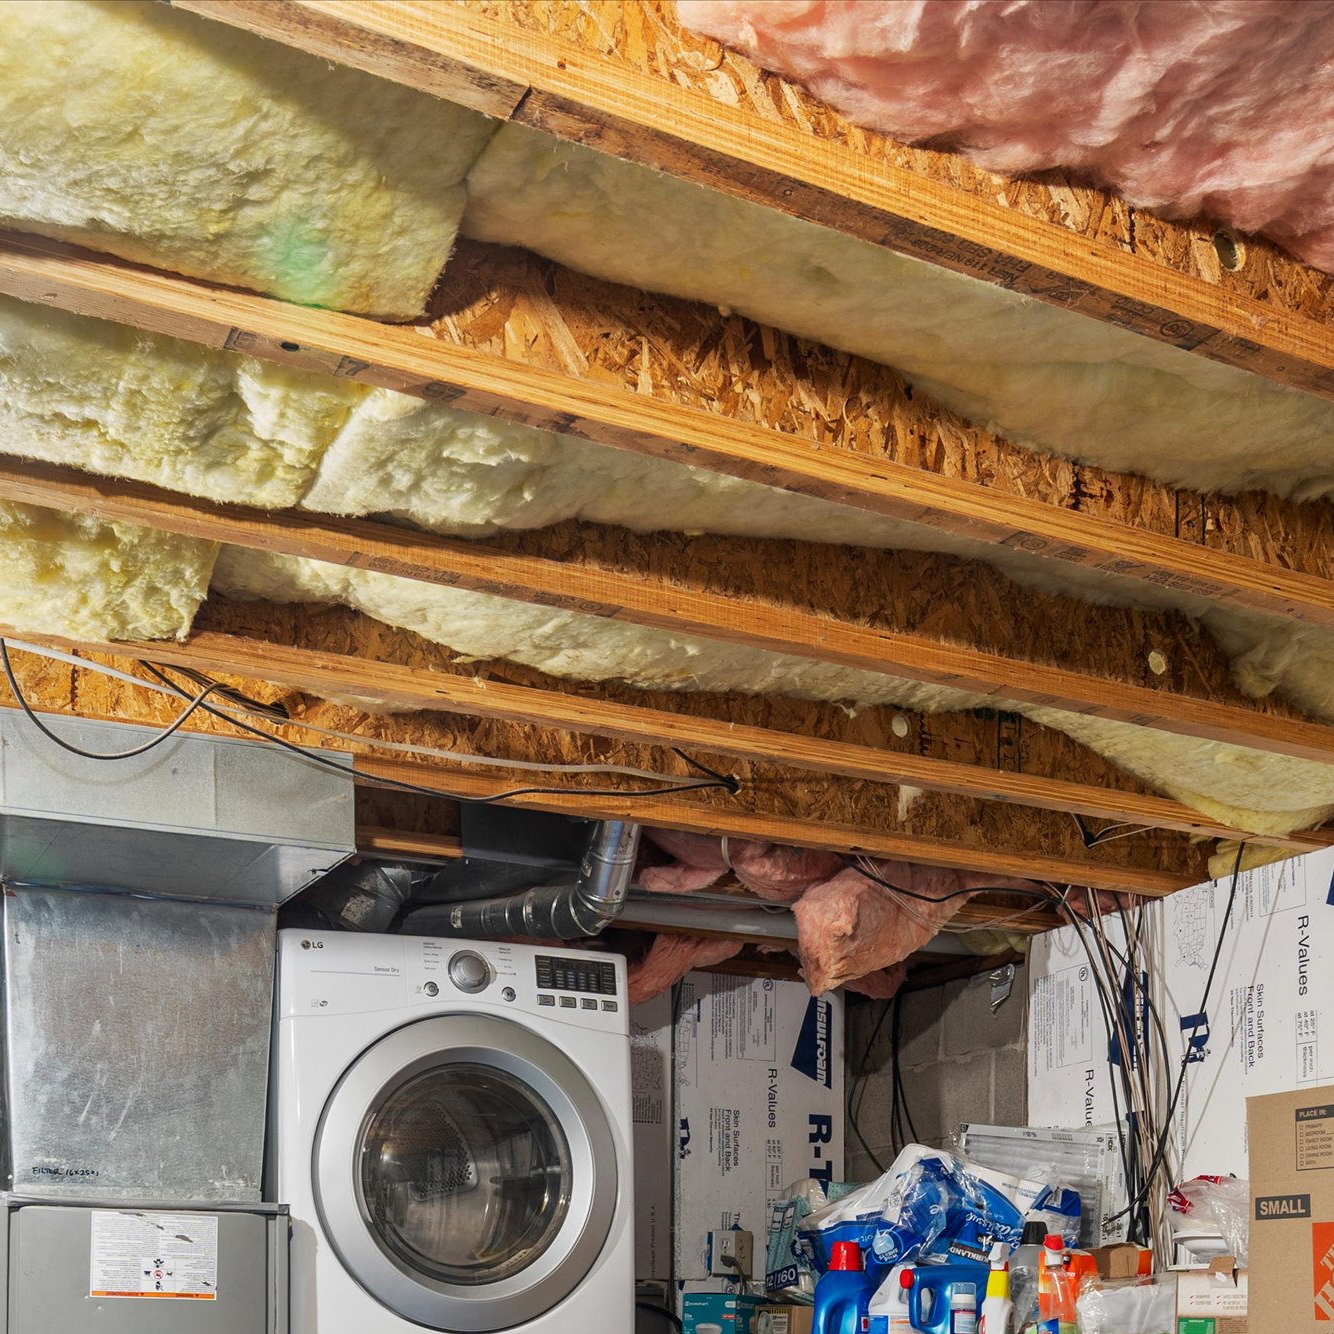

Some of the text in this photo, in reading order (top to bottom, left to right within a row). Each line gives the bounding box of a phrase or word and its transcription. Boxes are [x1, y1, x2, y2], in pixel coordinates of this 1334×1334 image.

[1297, 915, 1311, 997] R-Values
[1247, 985, 1256, 1069] Front and Back
[1257, 983, 1265, 1059] Skin Surfaces
[768, 1067, 778, 1129] R-Values
[1084, 1069, 1095, 1128] R-Value
[1298, 1109, 1318, 1118] PLACE
[31, 1166, 64, 1178] FILTER
[732, 1129, 740, 1168] Surfaces
[1259, 1198, 1307, 1216] SMALL
